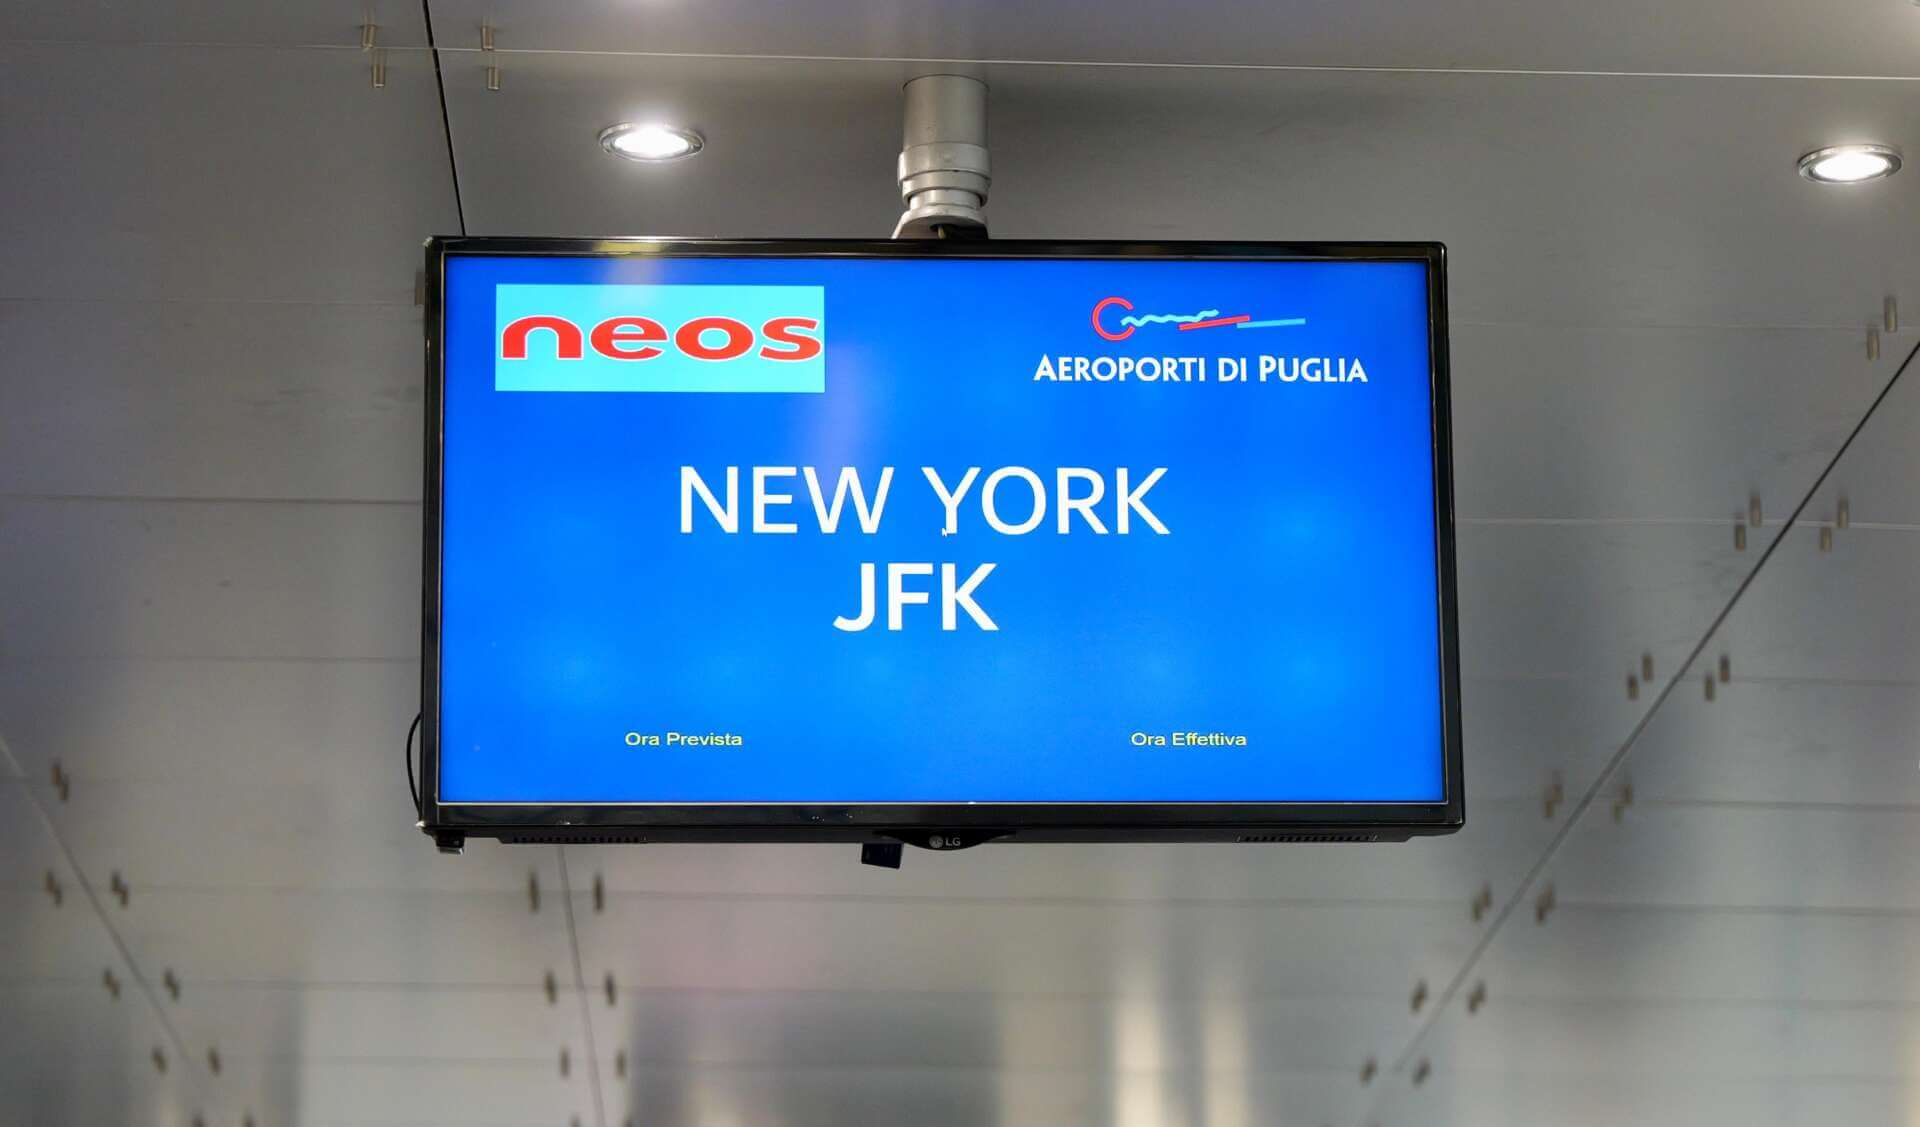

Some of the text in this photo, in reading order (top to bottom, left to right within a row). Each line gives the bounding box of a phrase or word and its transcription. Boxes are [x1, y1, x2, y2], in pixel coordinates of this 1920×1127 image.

[501, 315, 822, 361] neos
[1033, 354, 1369, 383] AEROPORTI DI PUGLIA
[680, 466, 1170, 537] NEW YORK
[833, 562, 999, 632] JFK
[624, 732, 743, 746] Ora Prevista
[1131, 732, 1247, 746] Ora Effettiva
